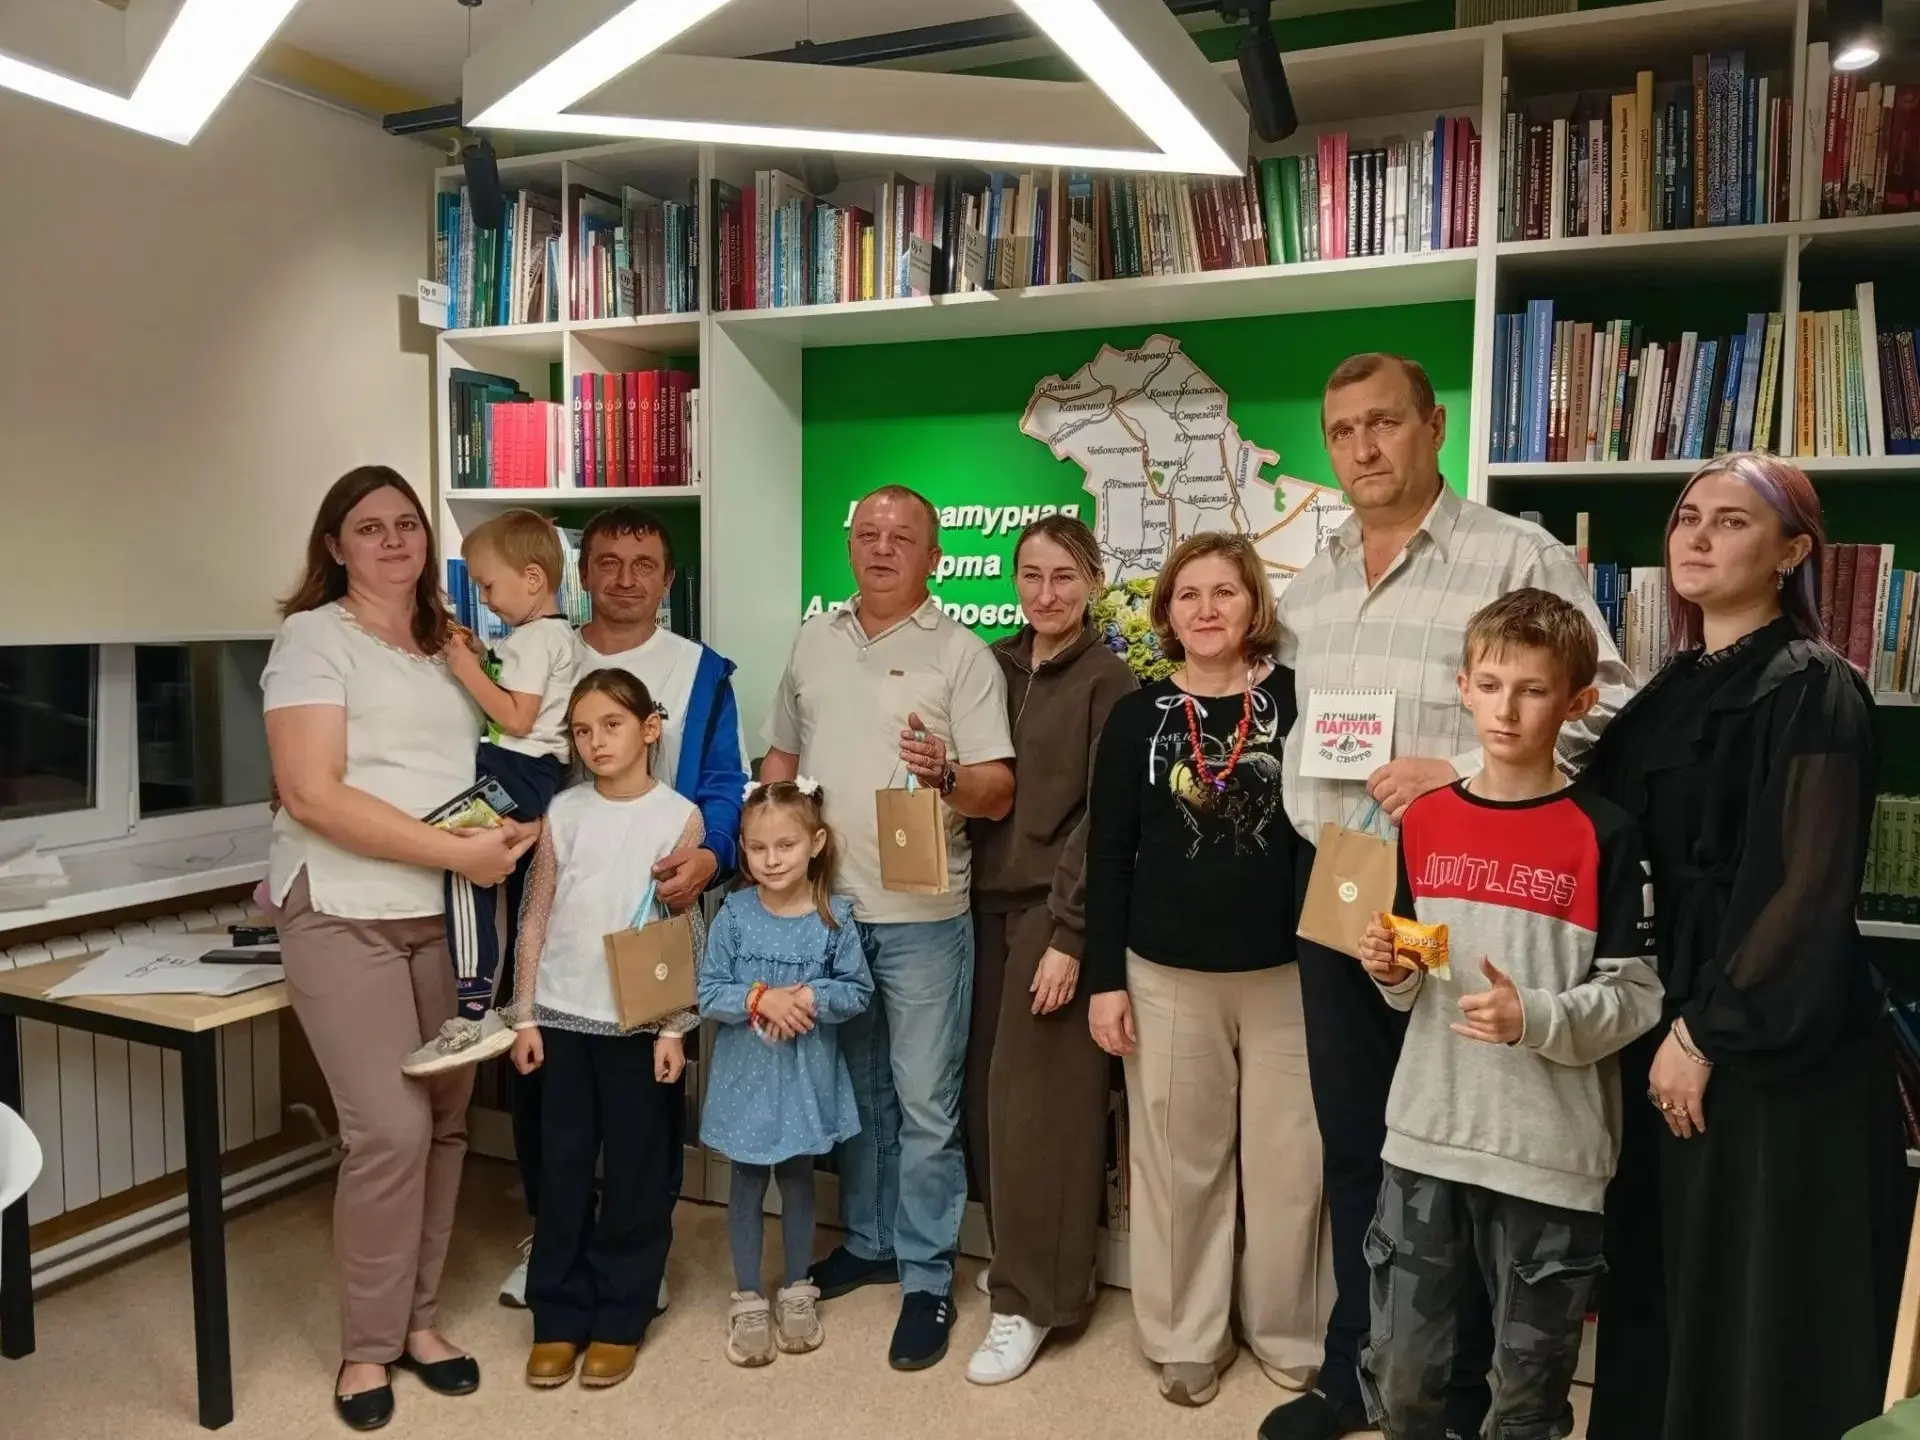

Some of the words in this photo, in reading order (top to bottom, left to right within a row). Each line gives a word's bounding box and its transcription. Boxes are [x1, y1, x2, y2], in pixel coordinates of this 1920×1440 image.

[420, 284, 431, 296] Ор
[1125, 351, 1165, 364] Яфарово
[1045, 381, 1081, 393] Дальний
[1058, 402, 1105, 413] Каликино
[1177, 411, 1222, 422] Стрелецк
[1174, 431, 1219, 443] Юртаево
[1087, 446, 1142, 456] Чебоксарово
[1188, 493, 1228, 504] Майский
[1315, 720, 1383, 735] ПАПУЛЯ
[1319, 748, 1333, 760] на
[1336, 750, 1372, 764] свете
[1416, 851, 1577, 907] IMITLESS
